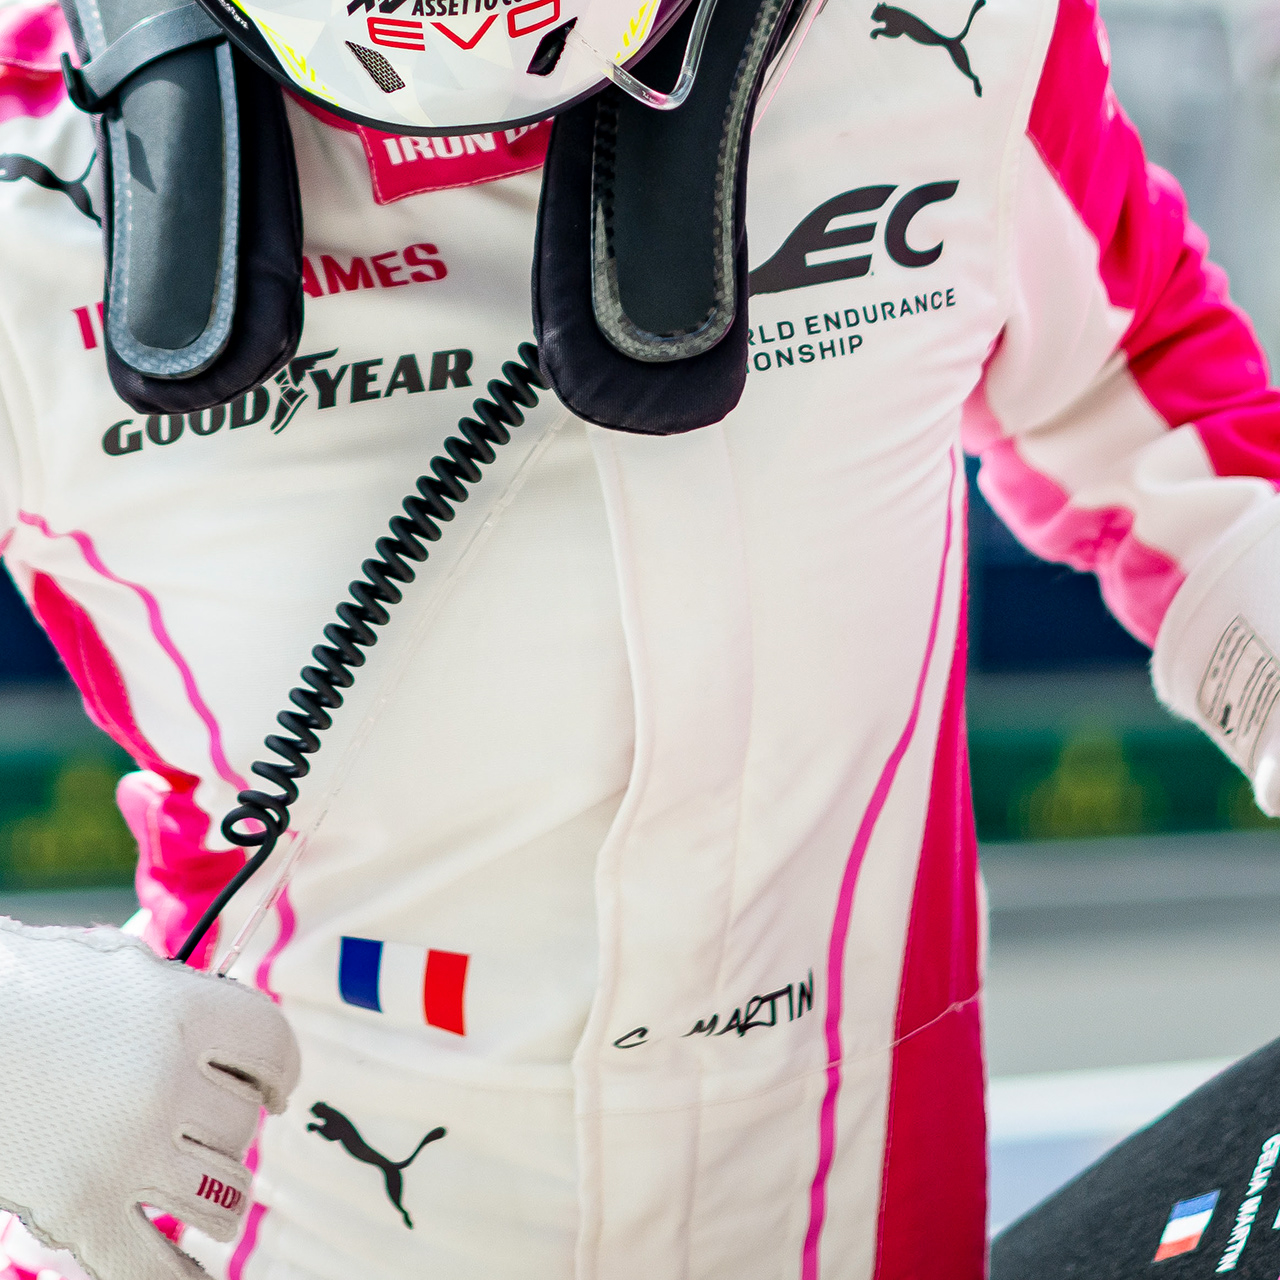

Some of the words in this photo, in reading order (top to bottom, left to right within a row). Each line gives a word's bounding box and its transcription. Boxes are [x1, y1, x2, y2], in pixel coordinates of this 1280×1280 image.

[302, 243, 449, 298] AMES
[748, 179, 960, 298] EC
[747, 320, 796, 346] RLD
[804, 287, 957, 336] ENDURANCE
[680, 967, 814, 1038] MARTIN
[1214, 1194, 1263, 1273] MARTIN
